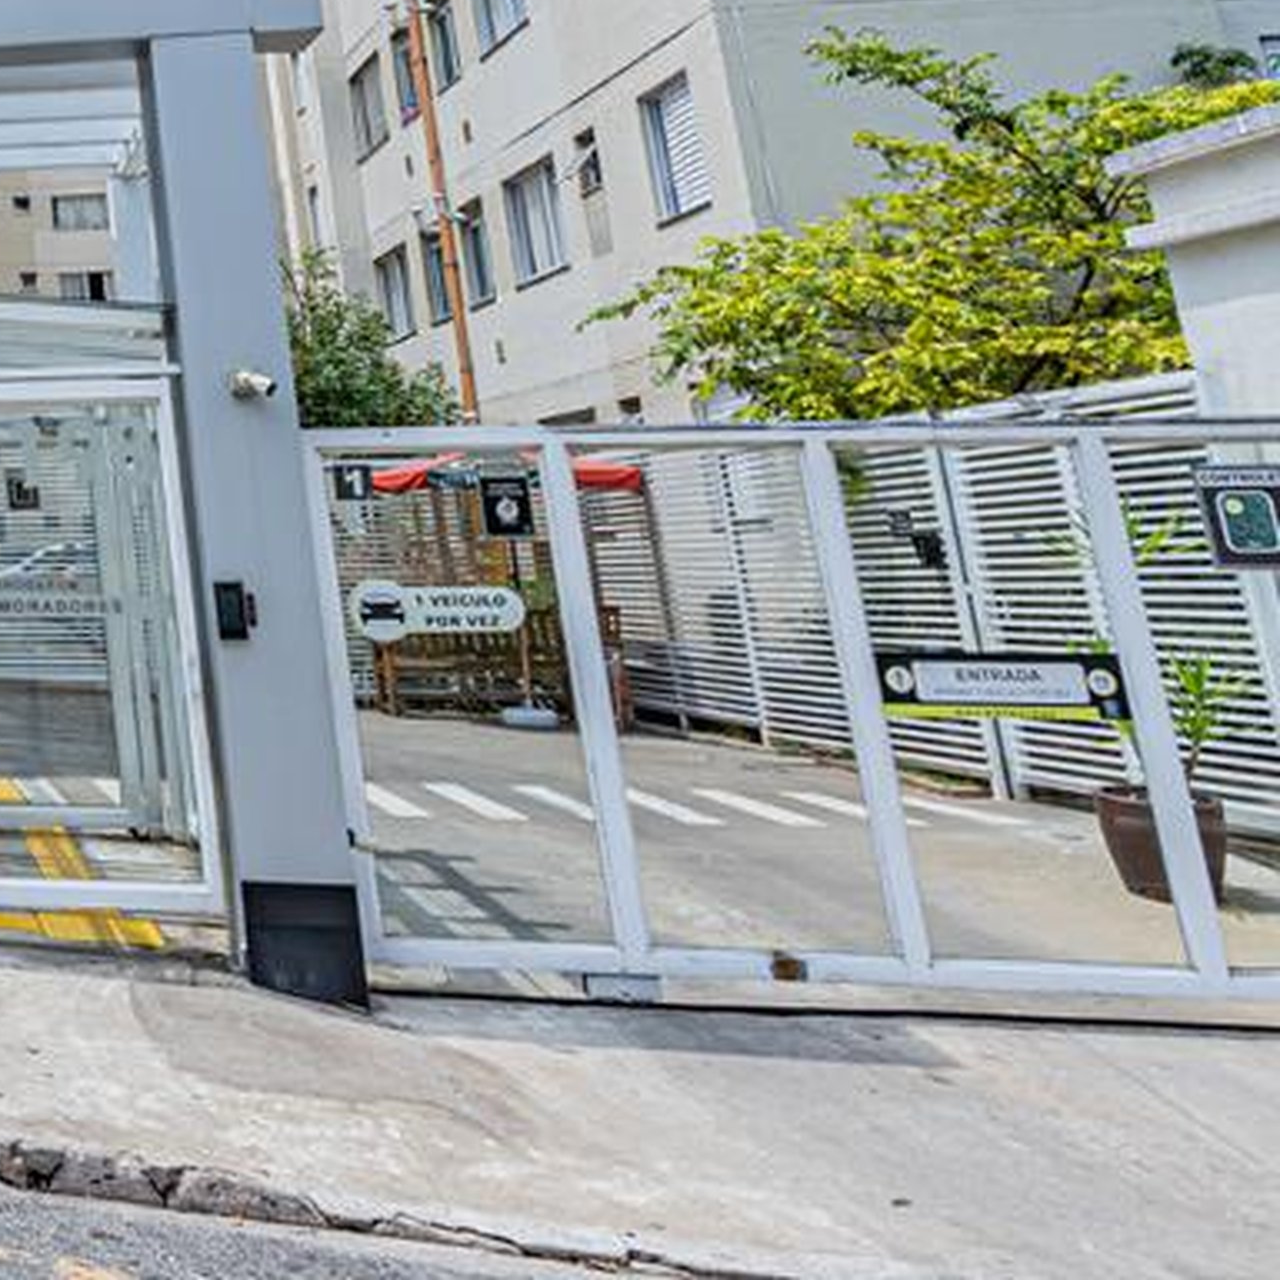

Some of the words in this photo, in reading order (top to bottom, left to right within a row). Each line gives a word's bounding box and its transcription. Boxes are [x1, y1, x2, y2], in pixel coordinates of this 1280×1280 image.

[345, 469, 365, 499] 1
[425, 614, 461, 627] POR
[465, 613, 501, 627] VEZ
[955, 668, 1042, 682] ENTRADA
